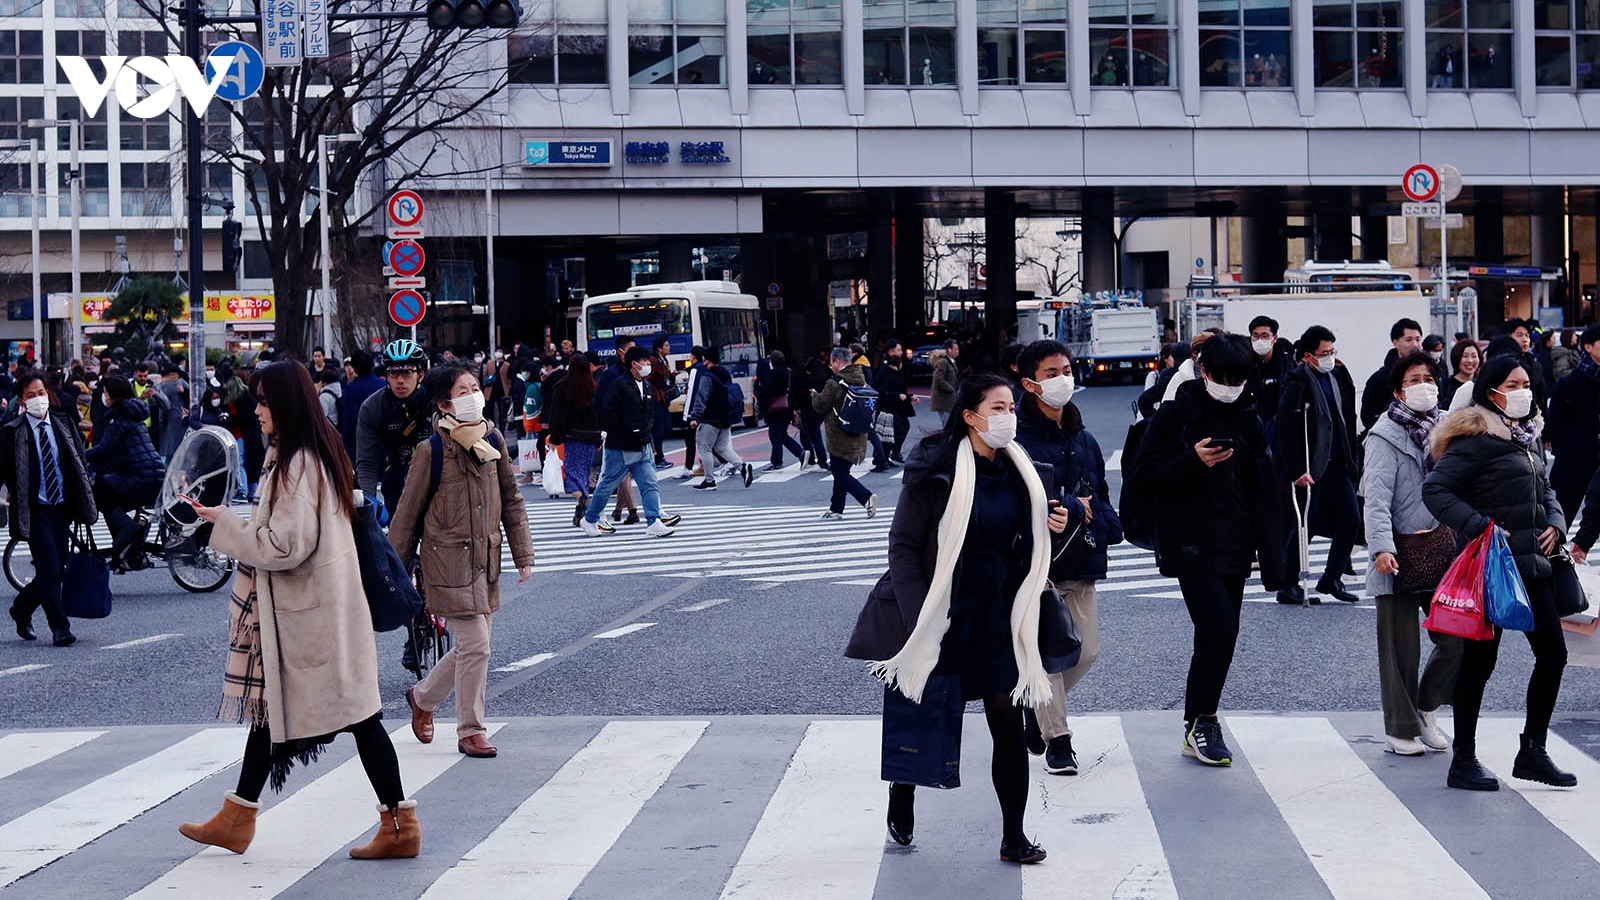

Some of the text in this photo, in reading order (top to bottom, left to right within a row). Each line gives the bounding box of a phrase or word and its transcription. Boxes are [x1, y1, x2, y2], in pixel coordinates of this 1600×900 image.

[561, 145, 597, 153] 東京メトロ
[1405, 206, 1437, 214] ここまで
[229, 299, 270, 308] 大当たりの
